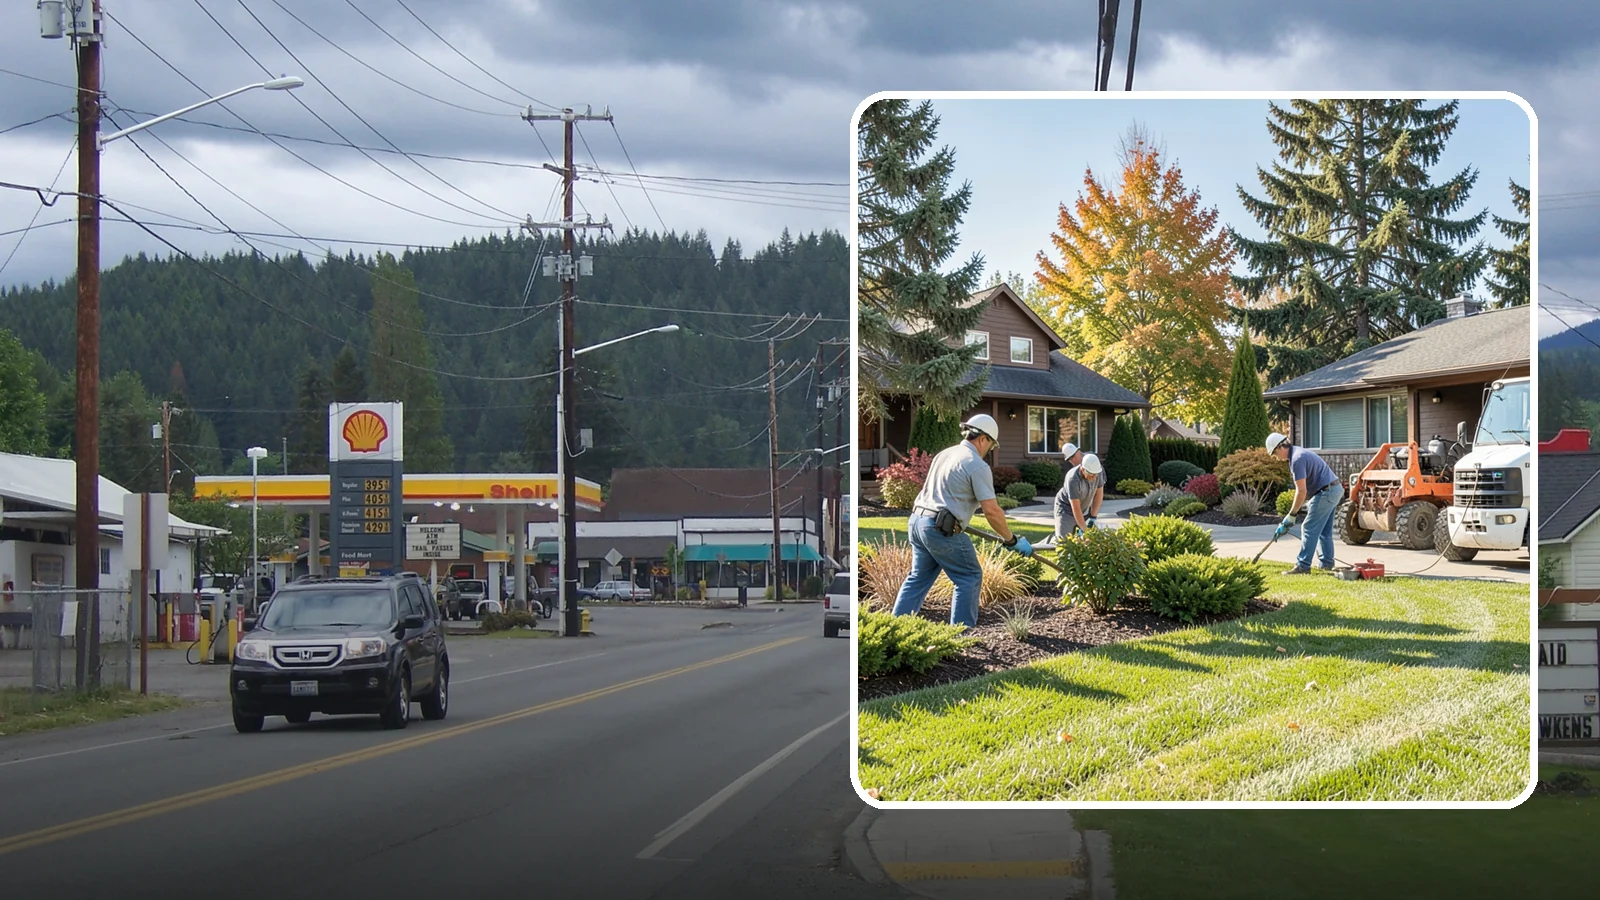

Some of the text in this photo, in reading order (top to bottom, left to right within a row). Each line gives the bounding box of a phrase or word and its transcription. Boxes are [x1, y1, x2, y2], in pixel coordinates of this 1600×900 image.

[366, 480, 383, 490] 395
[490, 485, 547, 498] Shell
[366, 494, 383, 504] 405
[366, 508, 383, 518] 415
[366, 522, 383, 532] 429
